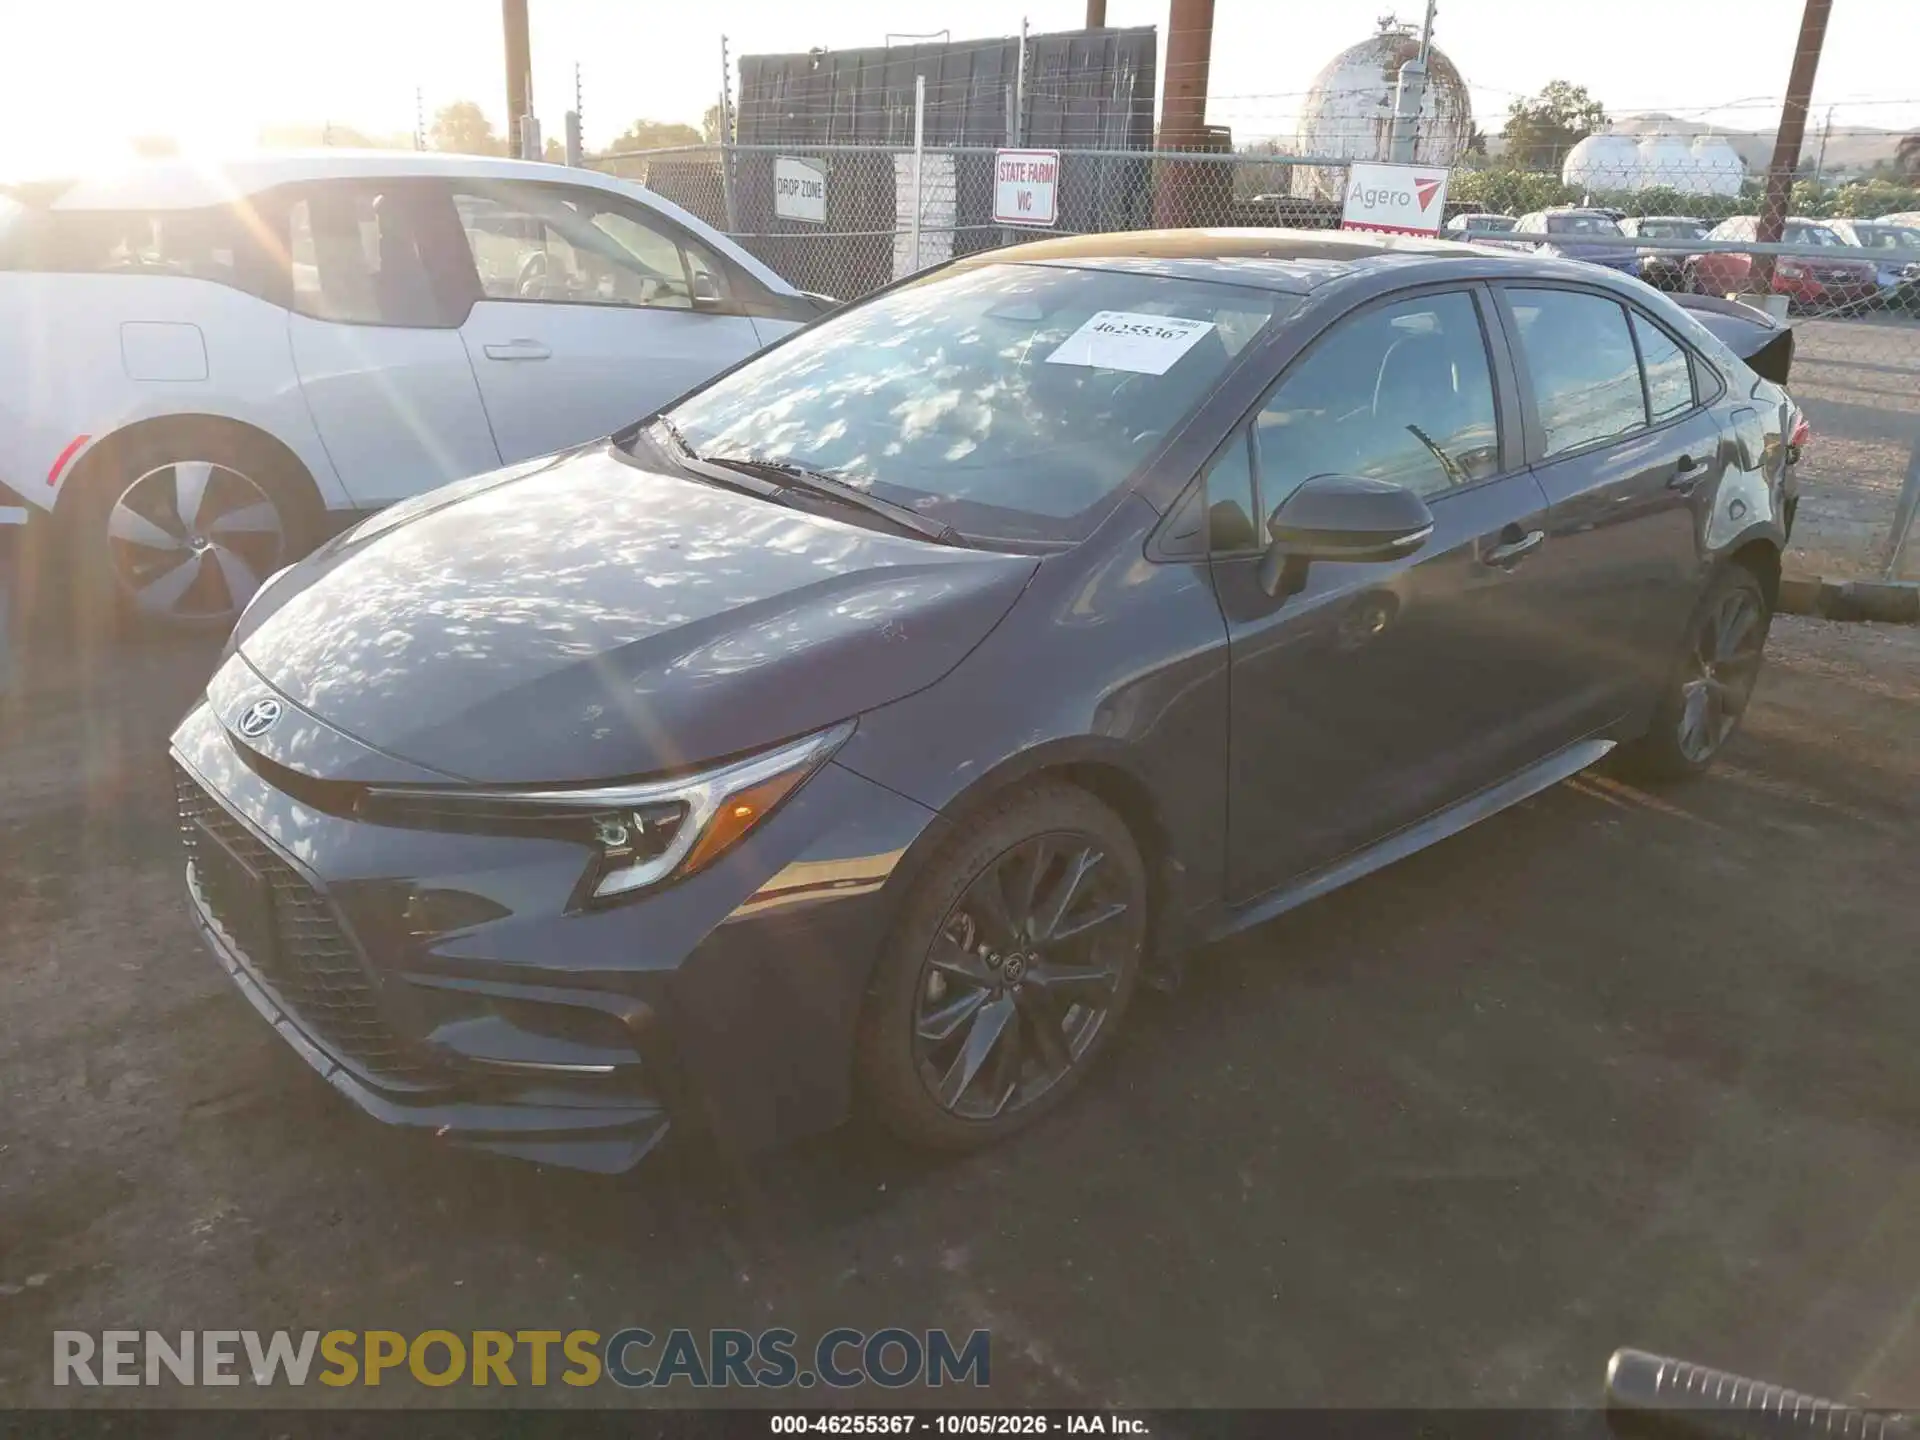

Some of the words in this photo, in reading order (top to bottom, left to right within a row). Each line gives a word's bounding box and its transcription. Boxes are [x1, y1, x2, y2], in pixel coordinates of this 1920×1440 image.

[1000, 162, 1027, 182] STATE
[1028, 164, 1053, 184] FARM
[777, 177, 799, 196] DROP
[801, 180, 823, 199] ZONE
[1350, 182, 1411, 208] Agero
[1017, 190, 1032, 211] VIC
[1093, 322, 1189, 340] 46255367
